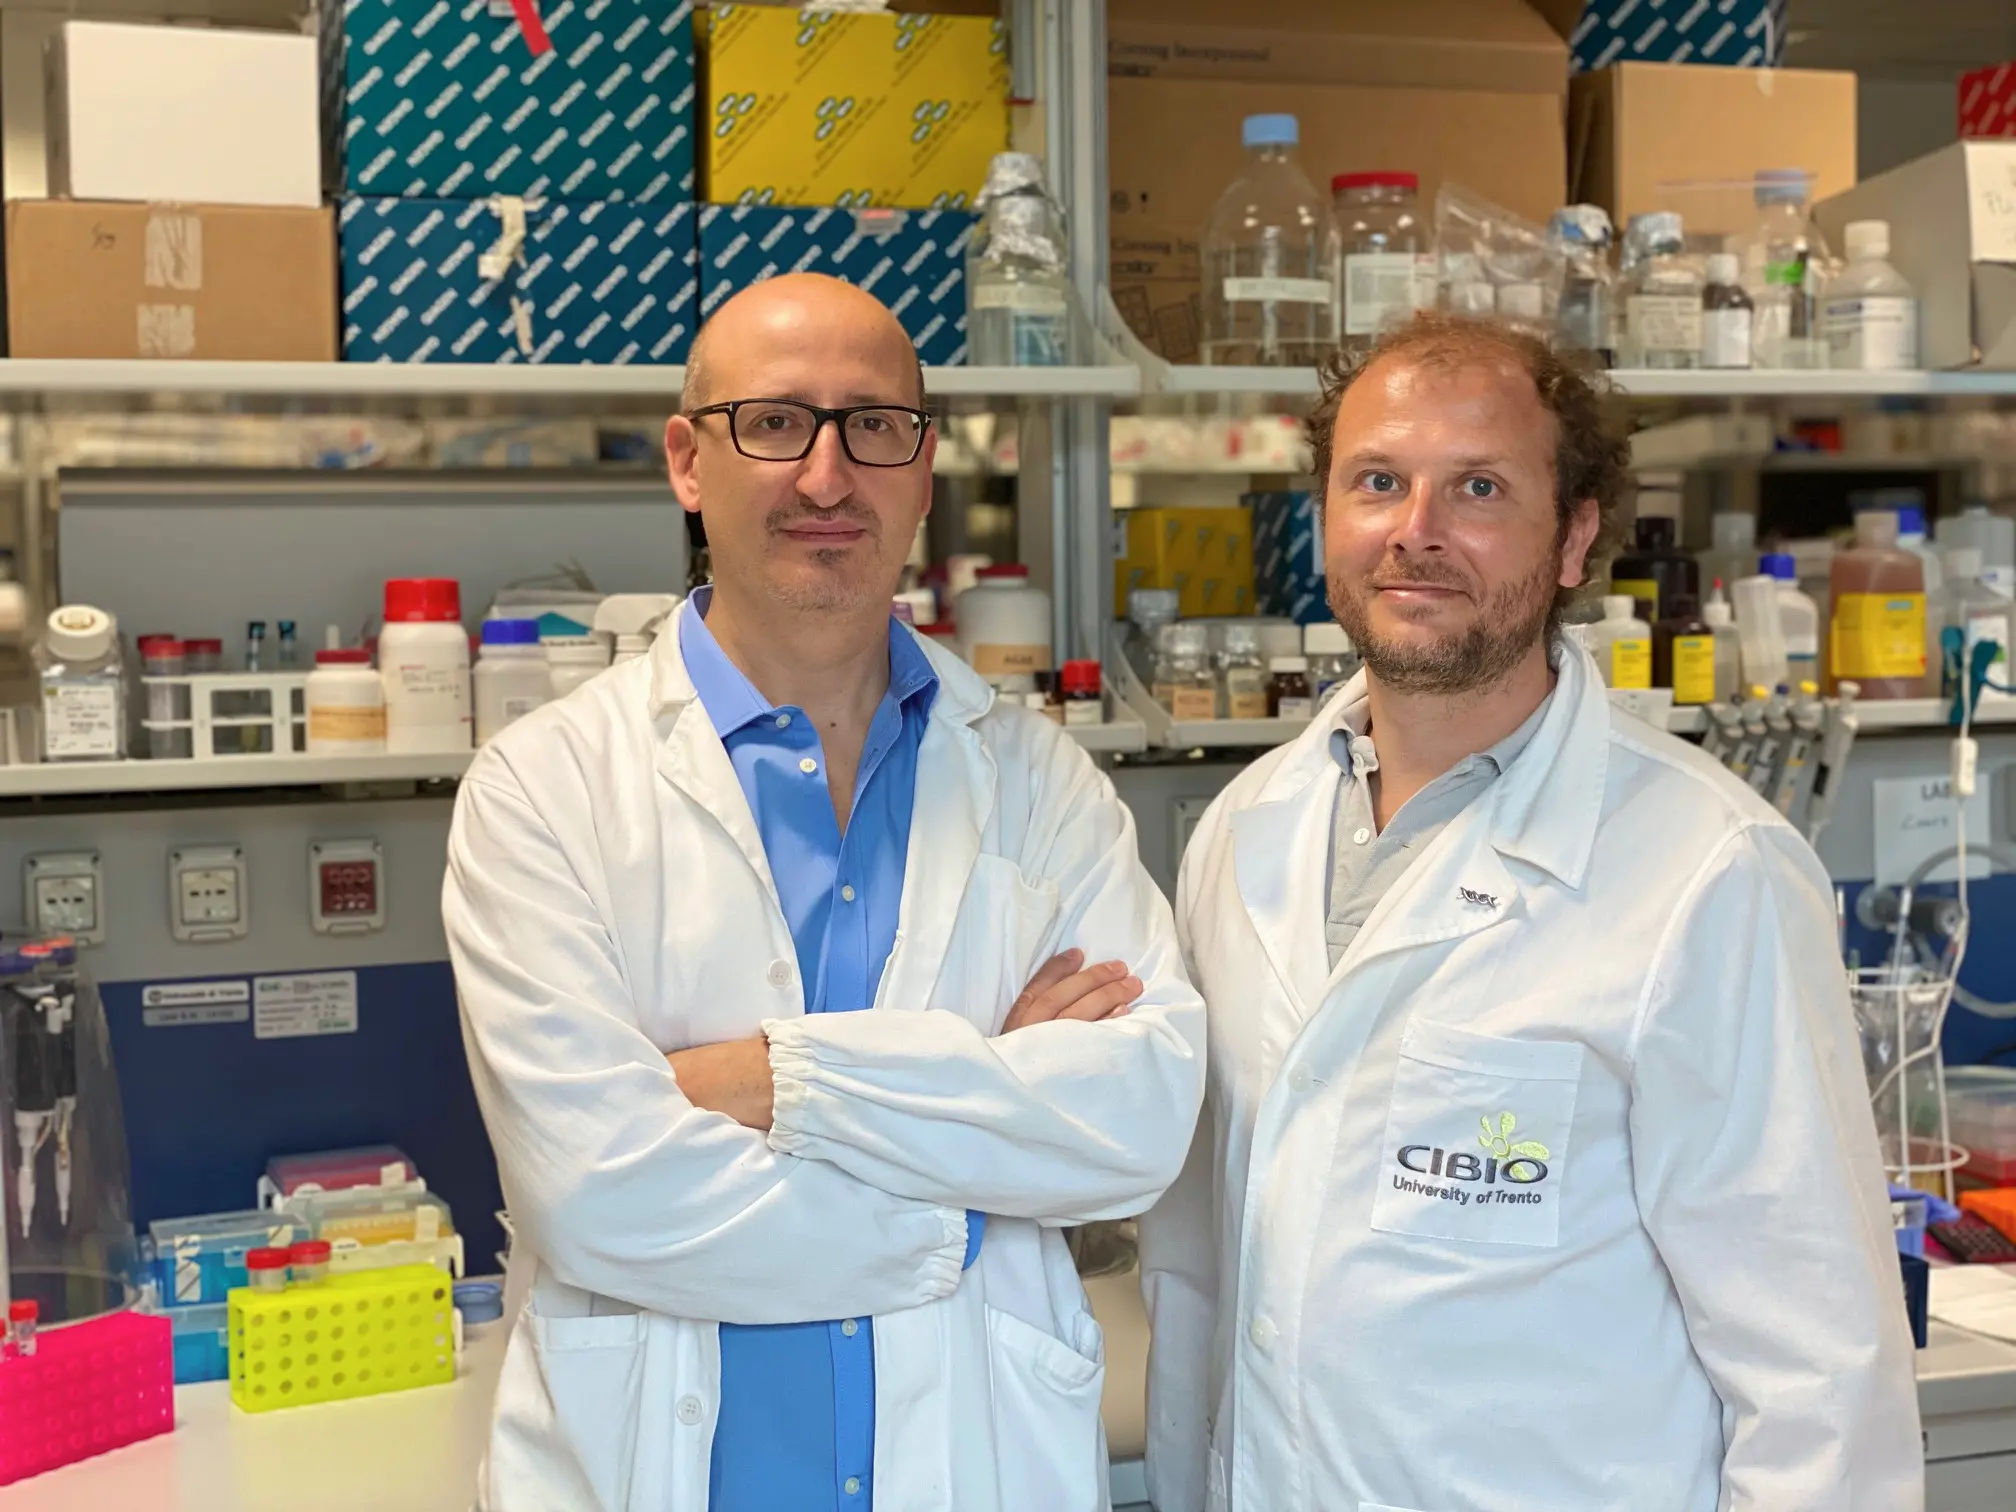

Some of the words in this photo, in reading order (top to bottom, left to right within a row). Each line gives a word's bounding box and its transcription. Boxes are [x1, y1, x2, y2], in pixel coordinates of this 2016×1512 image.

[1397, 1145, 1549, 1184] CIBIO
[1393, 1174, 1470, 1206] University
[1476, 1190, 1492, 1204] of
[1495, 1190, 1542, 1204] Trento
